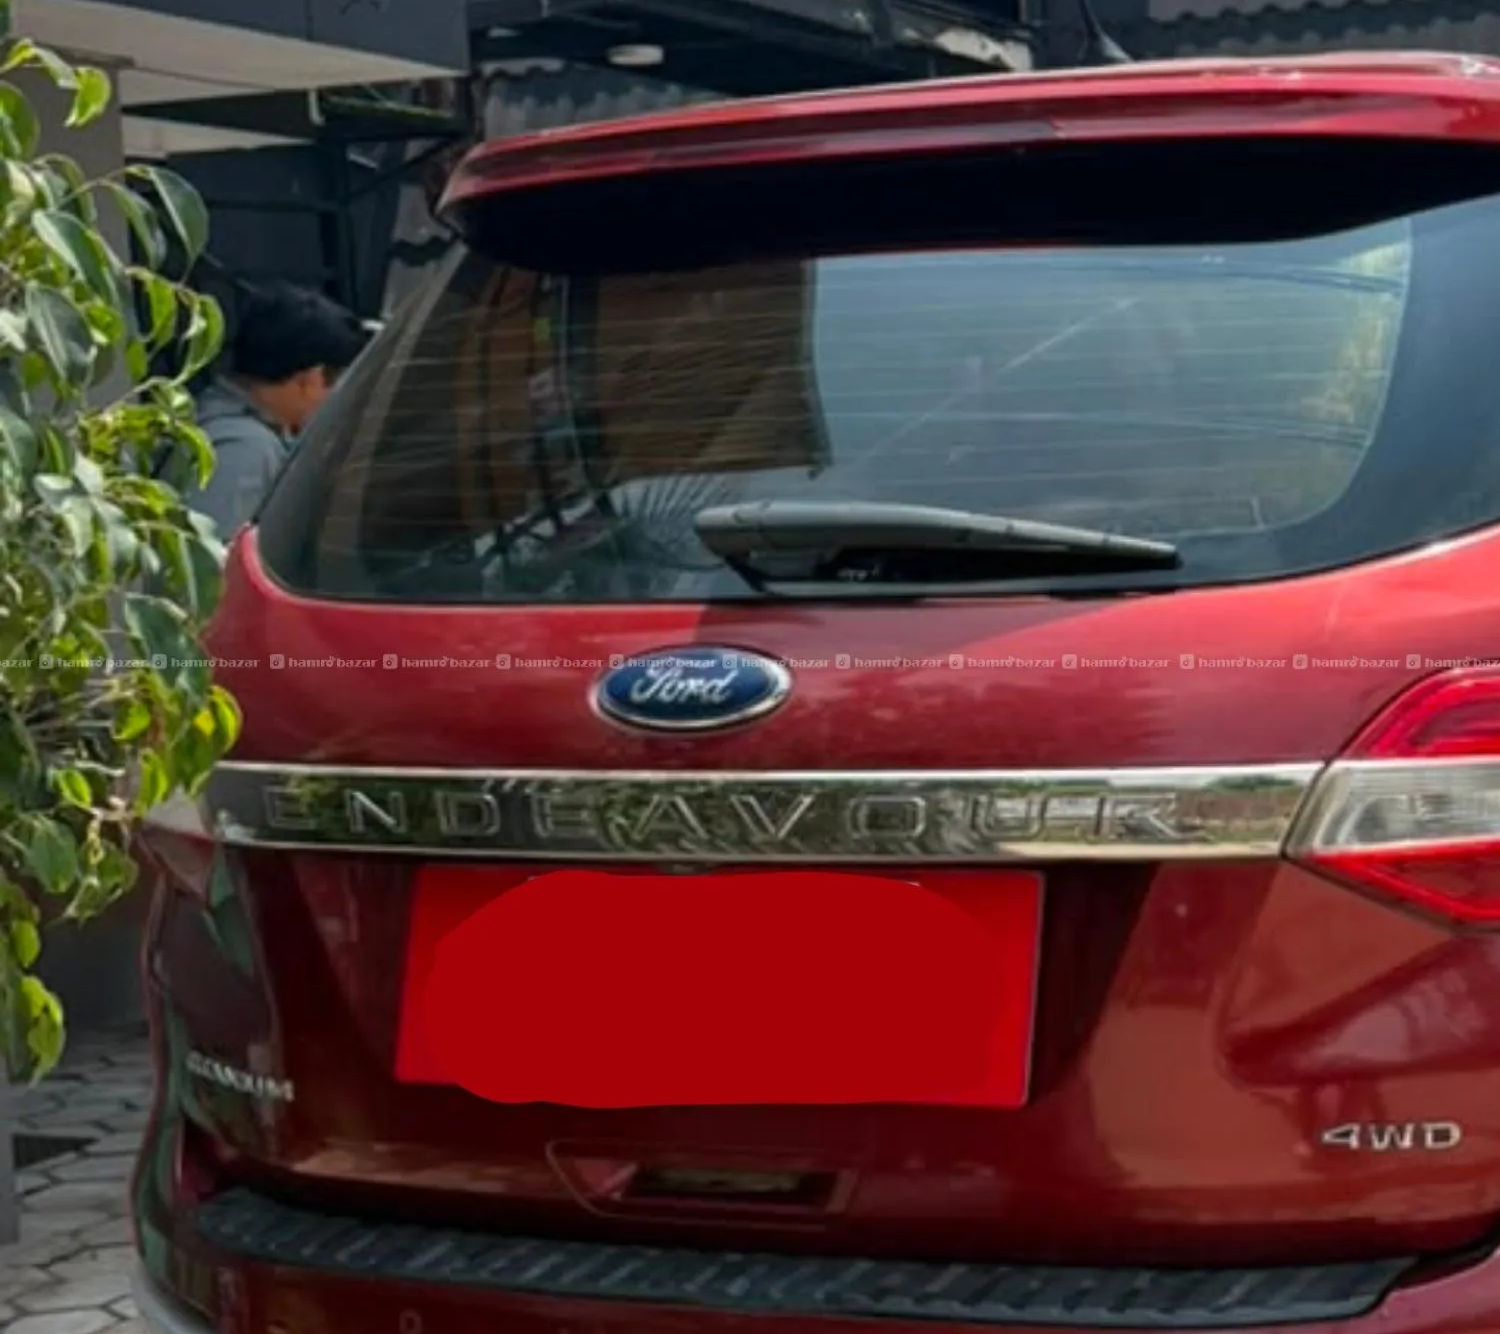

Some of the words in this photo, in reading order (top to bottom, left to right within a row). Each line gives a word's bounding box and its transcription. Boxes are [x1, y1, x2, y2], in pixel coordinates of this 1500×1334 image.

[629, 667, 738, 703] Ford
[262, 787, 1205, 842] ENDEAVOUR
[1321, 1122, 1461, 1150] 4WD
